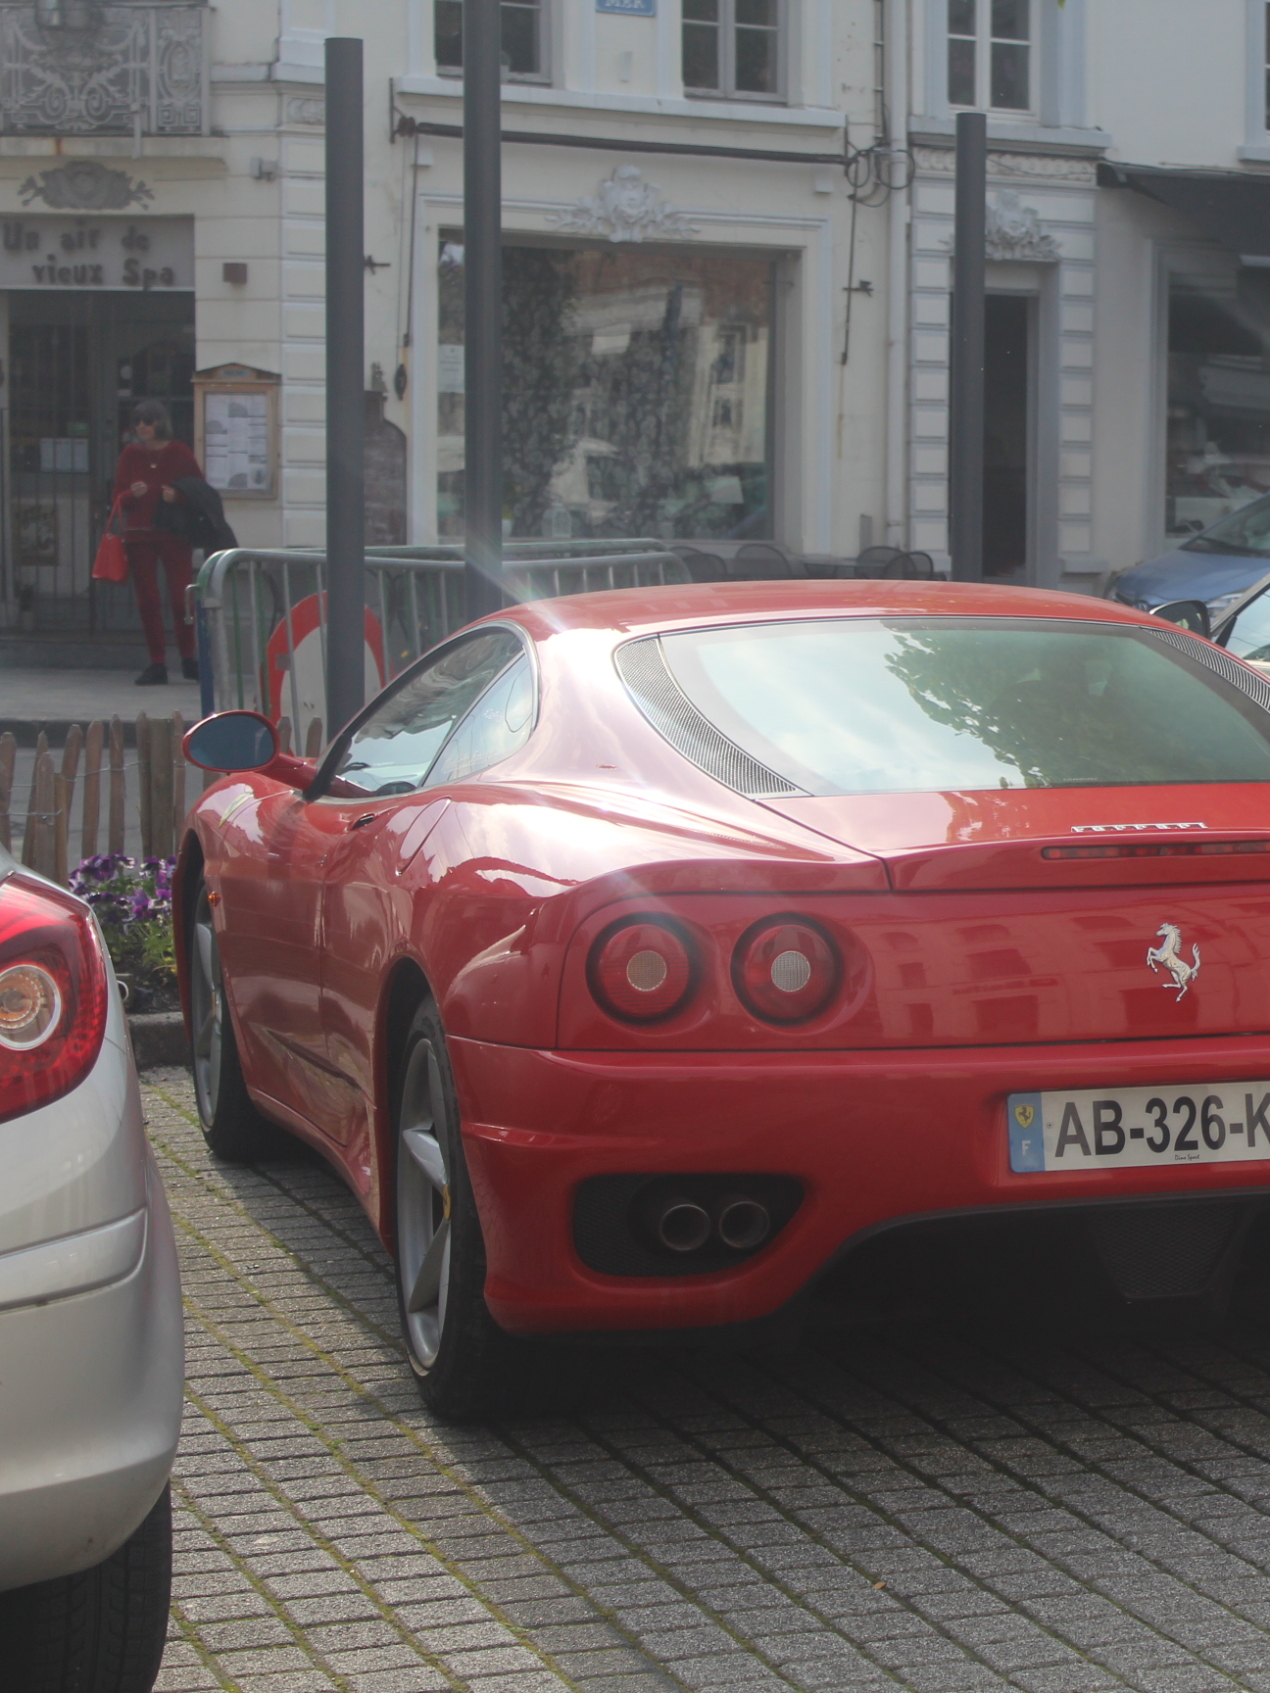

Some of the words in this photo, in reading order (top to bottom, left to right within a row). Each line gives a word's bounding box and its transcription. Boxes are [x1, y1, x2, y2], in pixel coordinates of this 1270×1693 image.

[3, 222, 40, 250] Un
[60, 218, 100, 250] air
[121, 225, 149, 250] de
[32, 254, 103, 285] vieux
[122, 258, 175, 291] Spa
[1021, 1139, 1032, 1156] F
